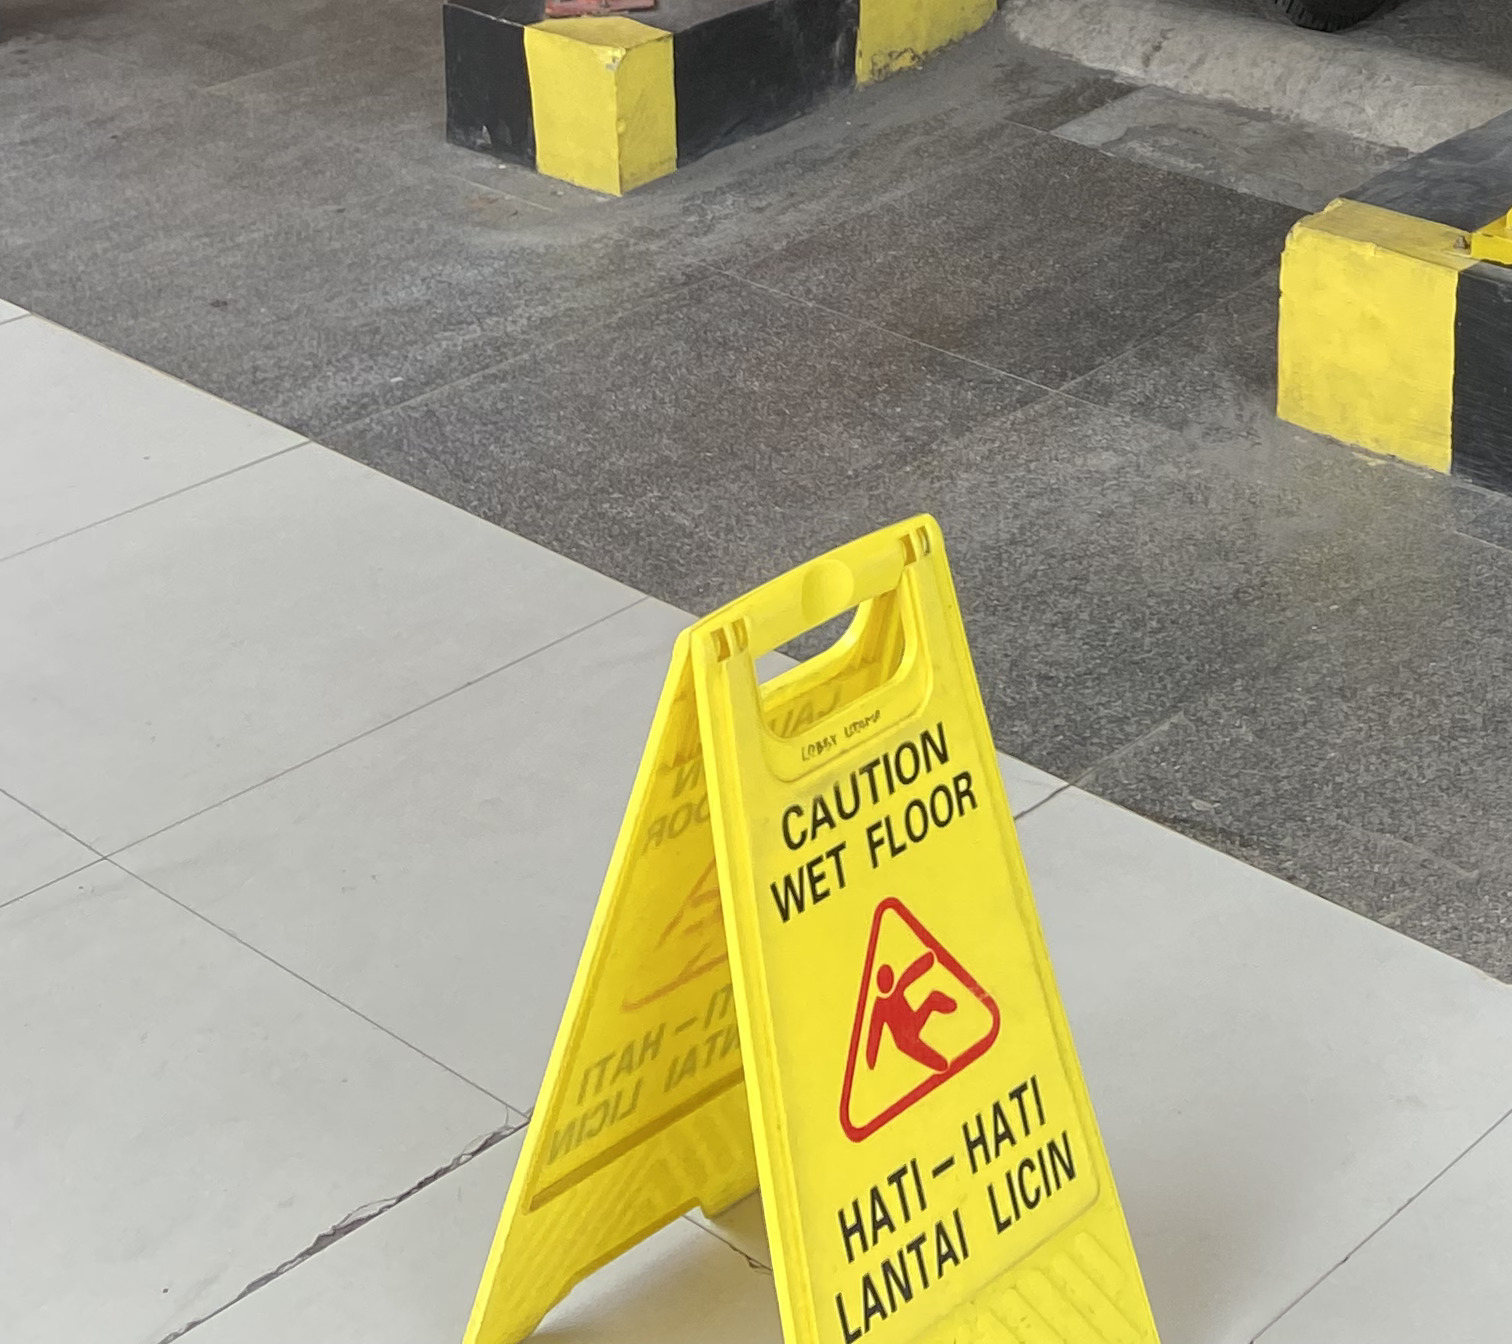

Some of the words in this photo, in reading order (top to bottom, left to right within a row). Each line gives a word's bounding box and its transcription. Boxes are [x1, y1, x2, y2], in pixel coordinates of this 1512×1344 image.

[769, 840, 847, 924] WET
[865, 770, 978, 870] FLOOR
[781, 720, 950, 851] CAUTION
[835, 1207, 970, 1344] LANTAI
[986, 1129, 1077, 1235] LICIN
